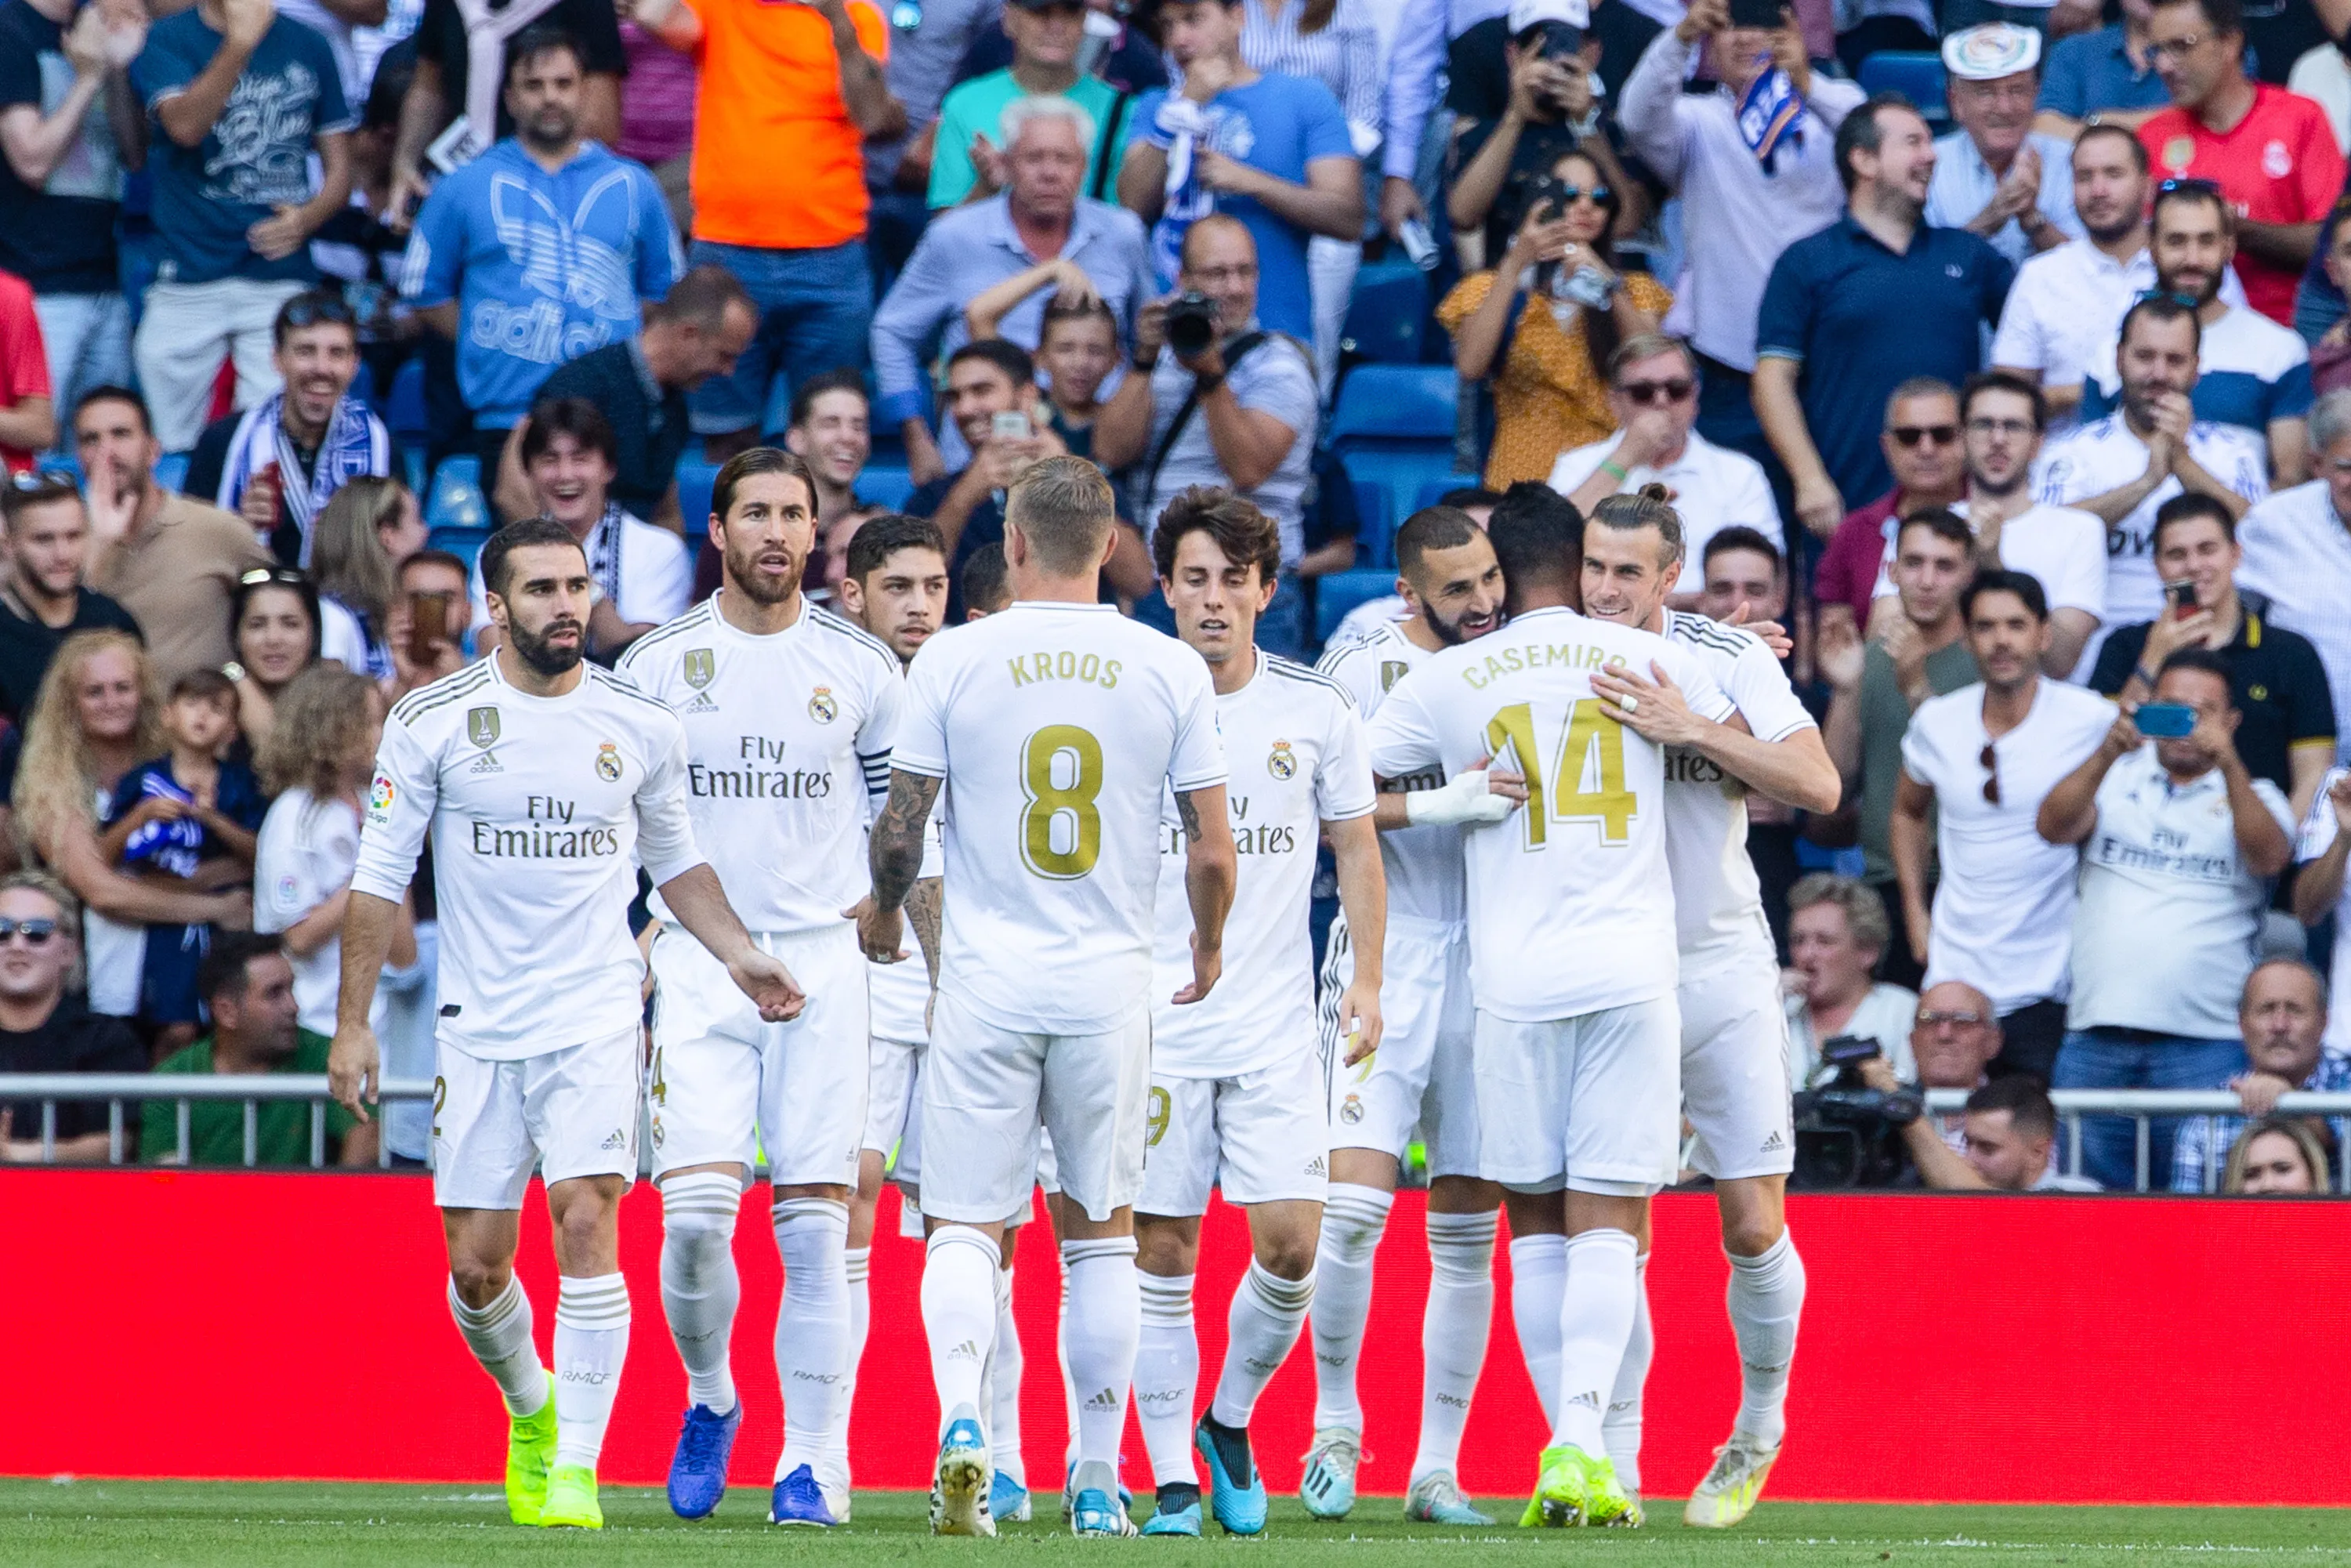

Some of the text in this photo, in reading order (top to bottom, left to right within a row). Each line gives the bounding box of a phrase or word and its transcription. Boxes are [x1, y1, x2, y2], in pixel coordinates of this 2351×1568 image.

[1006, 650, 1122, 689] KROOS
[686, 704, 719, 714] adidas
[740, 736, 785, 764] Fly
[469, 762, 505, 773] adidas
[686, 762, 831, 798] Emirates
[1480, 697, 1639, 853] 14
[527, 795, 574, 825] Fly
[1018, 723, 1103, 881] 8
[472, 820, 618, 858] Emirates
[561, 1370, 612, 1385] RMCF
[1138, 1388, 1186, 1403] RMCF
[1435, 1392, 1470, 1409] RMC
